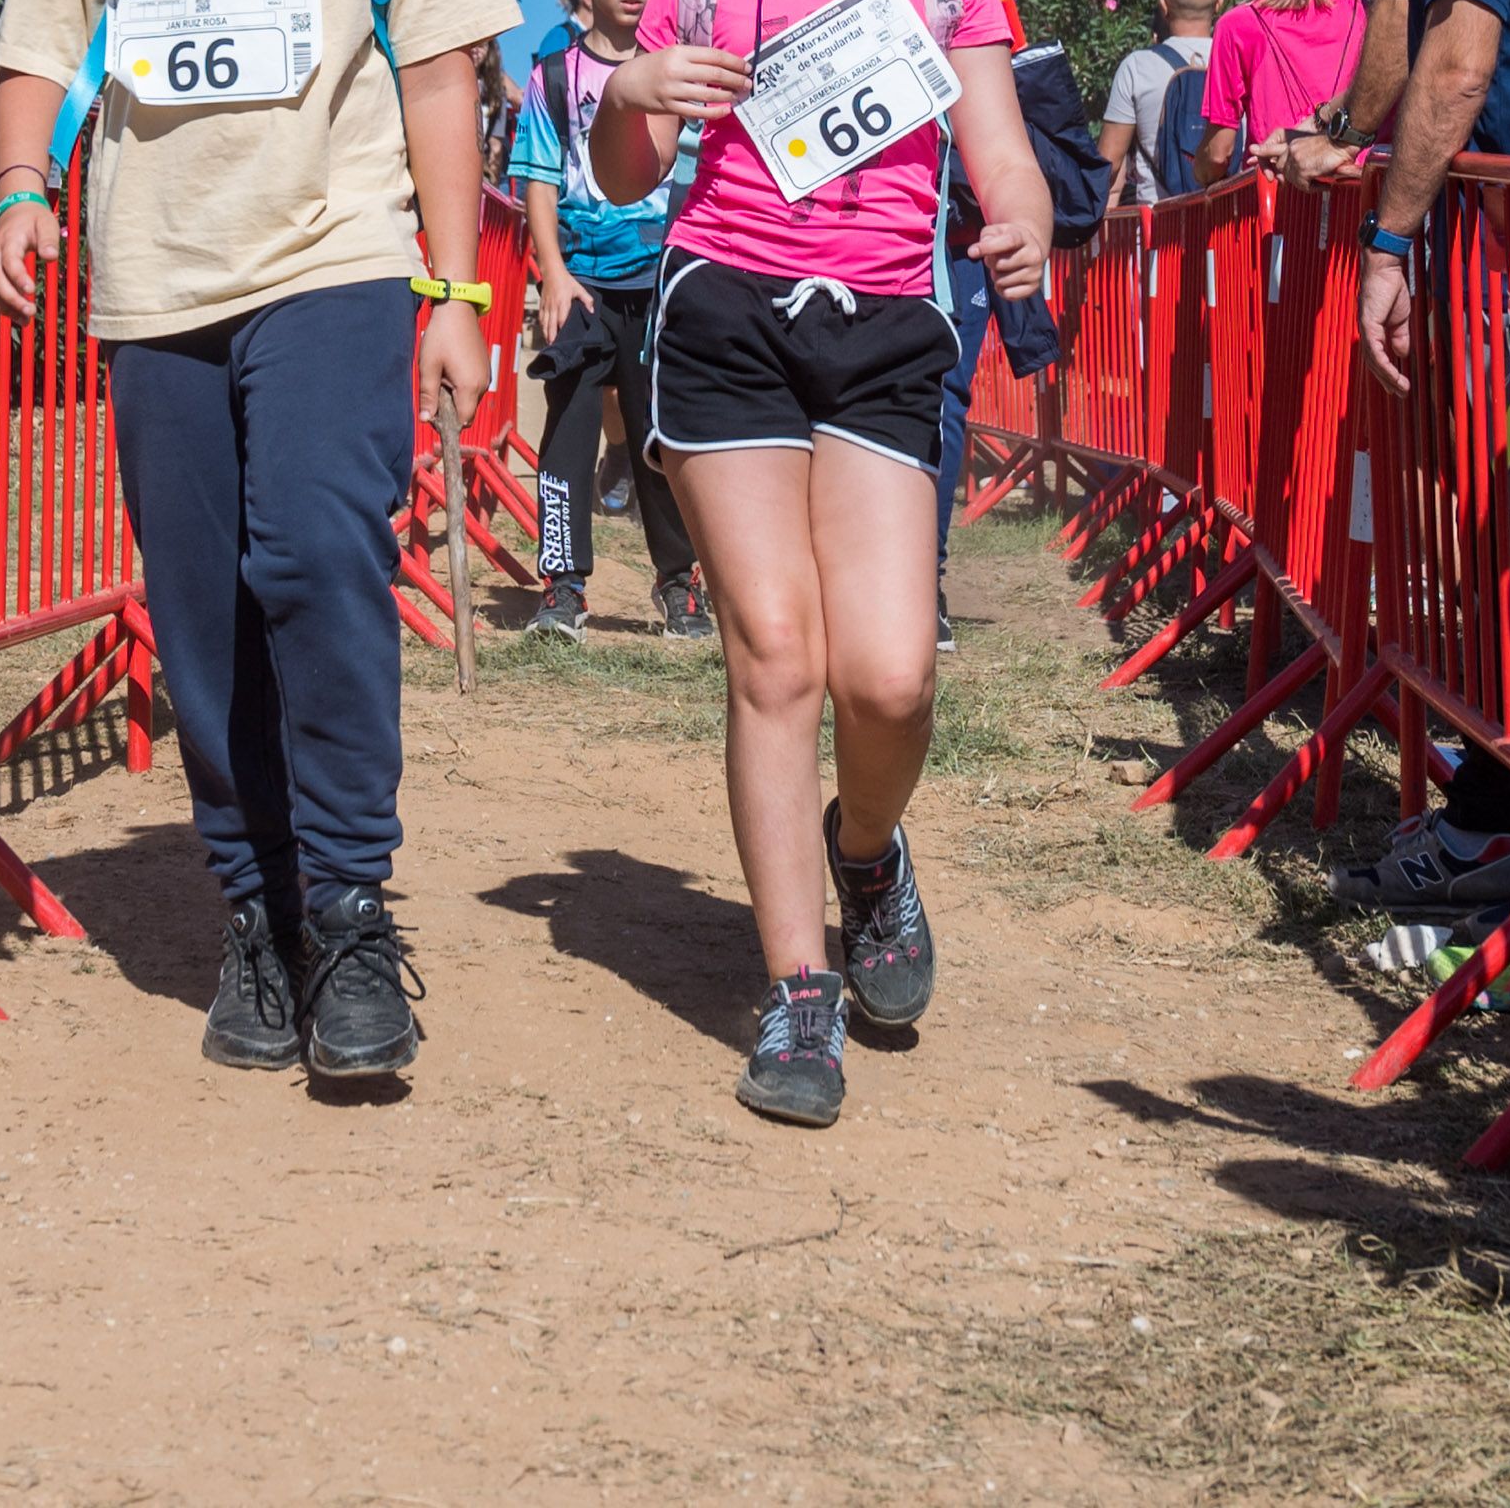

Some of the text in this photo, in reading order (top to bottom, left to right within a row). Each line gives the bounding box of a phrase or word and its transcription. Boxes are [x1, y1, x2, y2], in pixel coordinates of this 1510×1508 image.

[165, 16, 228, 31] JAN RUIZ ROSA
[783, 48, 798, 63] 52
[796, 30, 829, 54] Marxa
[829, 9, 862, 36] Infantil
[797, 60, 812, 72] de
[810, 26, 865, 65] Regularitat
[167, 37, 240, 92] 66
[774, 102, 809, 125] CLAUDIA
[808, 76, 852, 109] ARMENGOL
[851, 56, 883, 80] ARANDA
[819, 86, 892, 157] 66
[539, 471, 570, 576] LAKERS
[561, 500, 575, 572] LOS ANGELES
